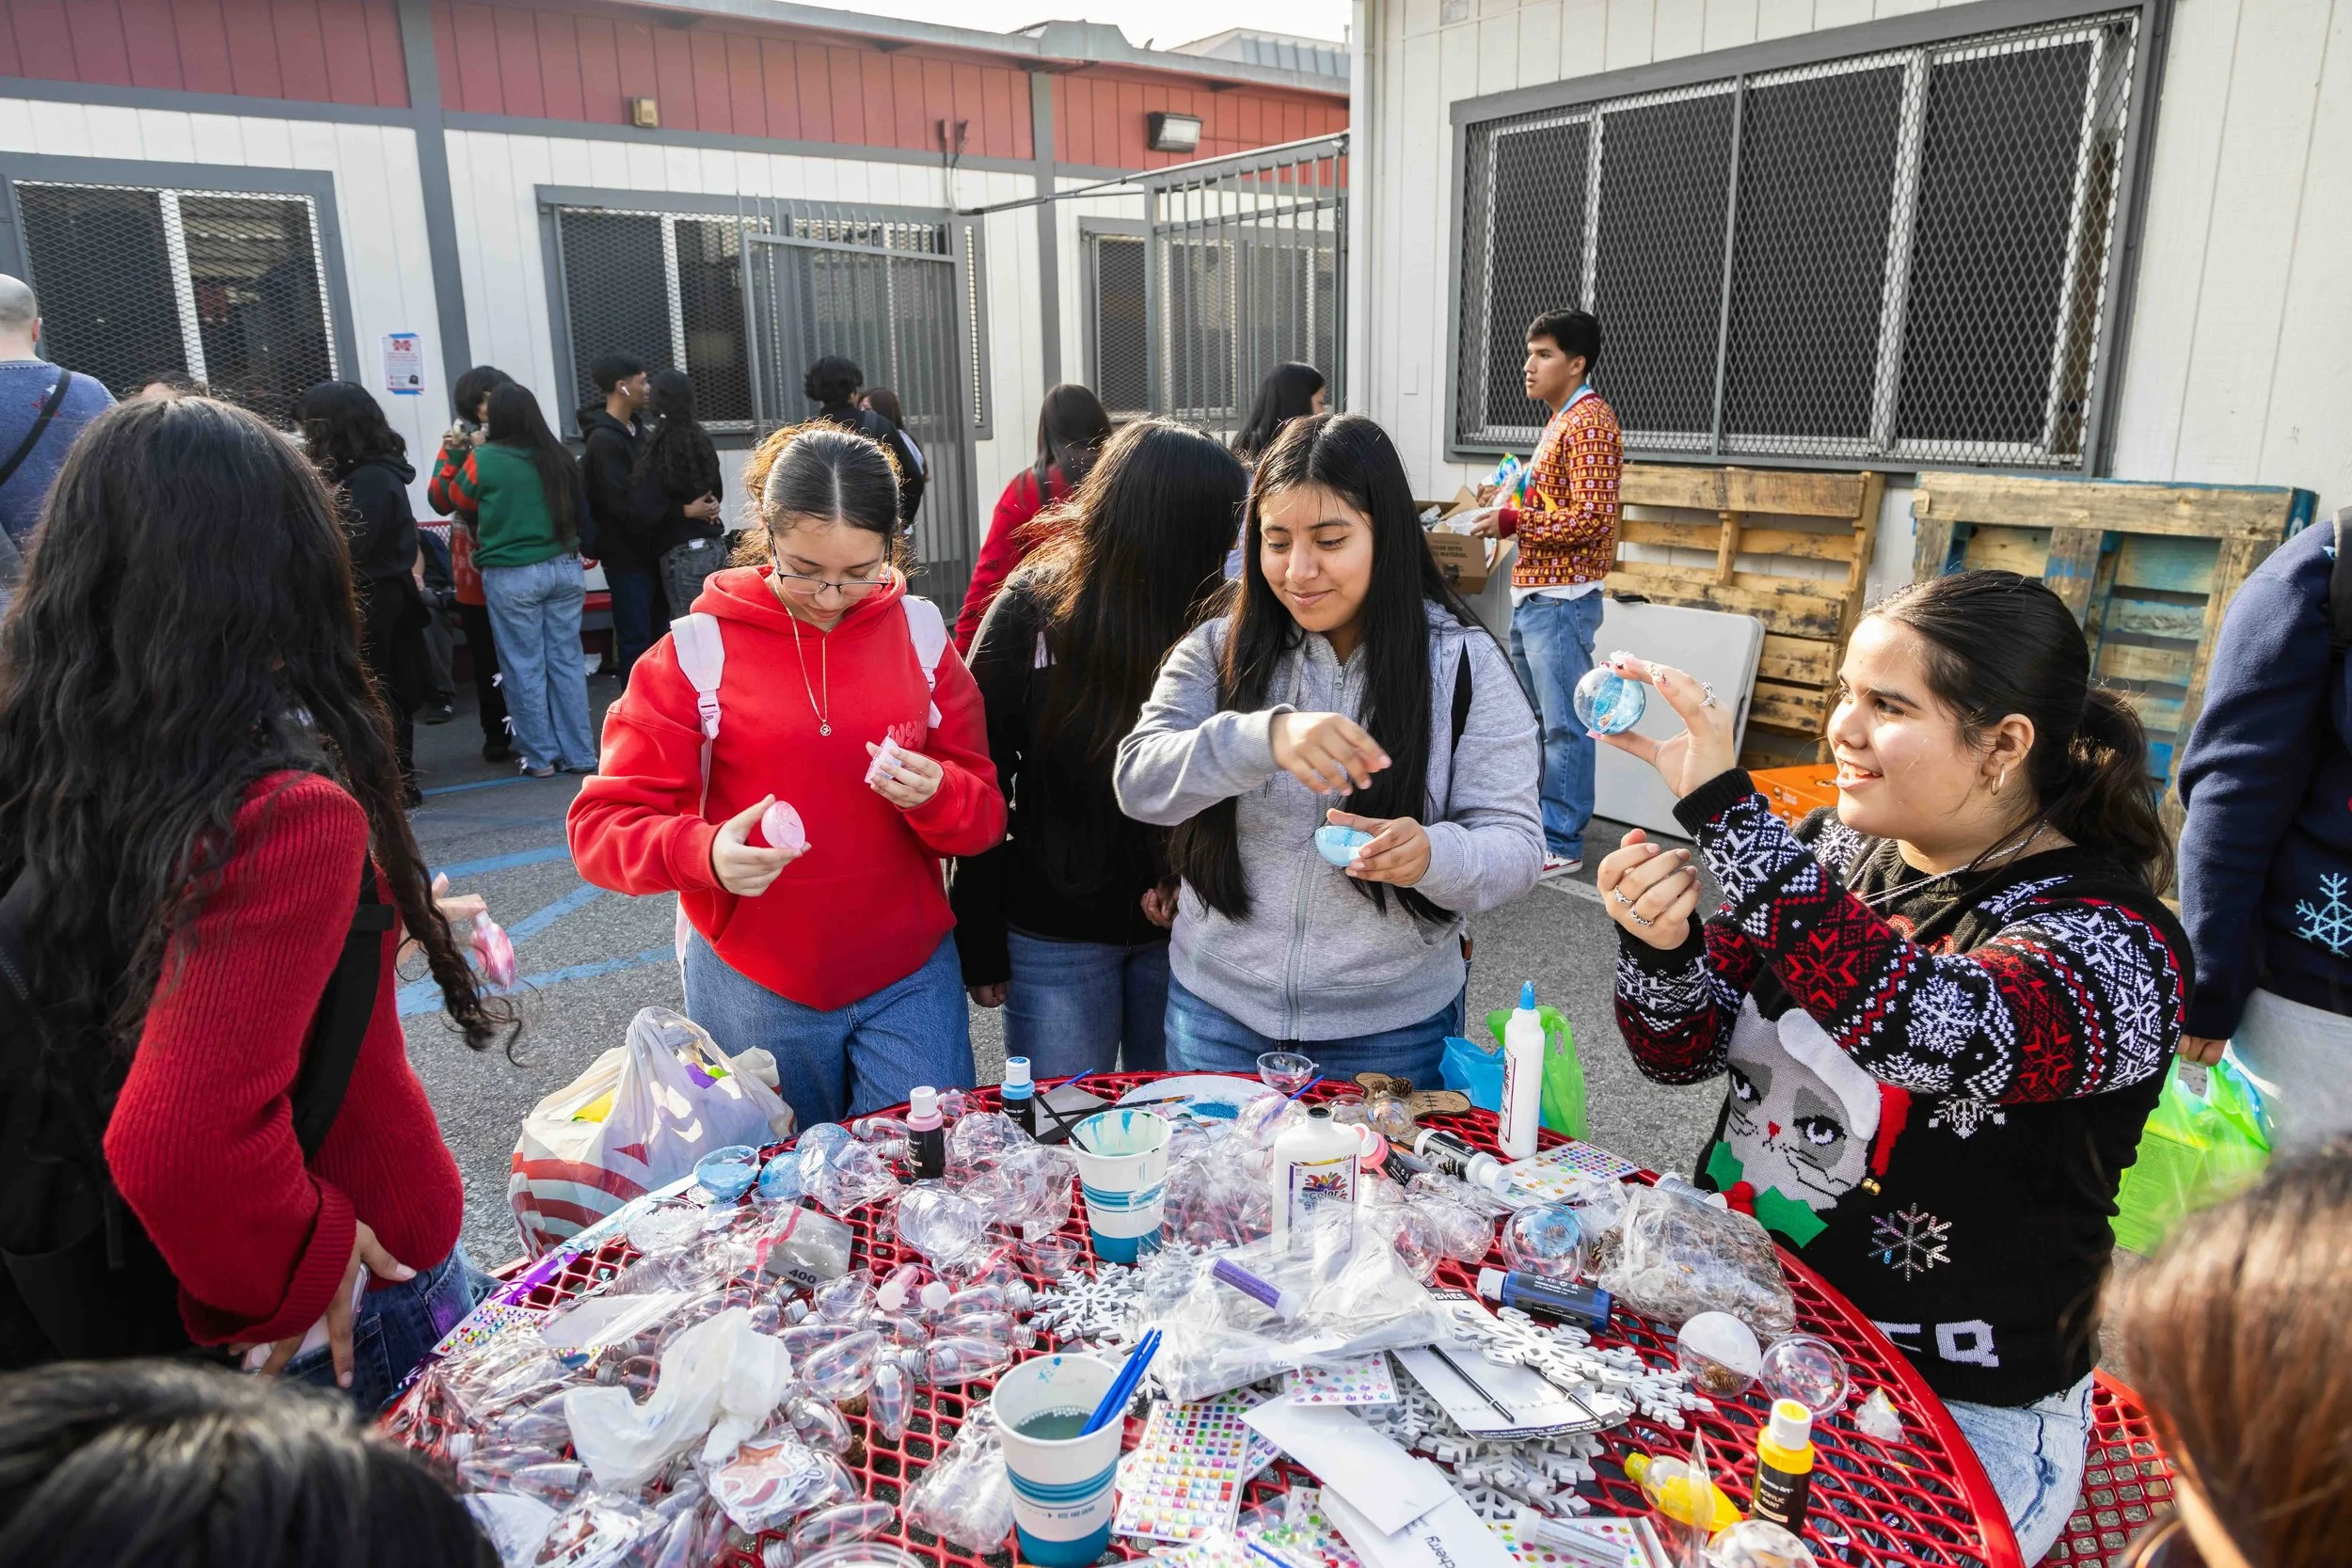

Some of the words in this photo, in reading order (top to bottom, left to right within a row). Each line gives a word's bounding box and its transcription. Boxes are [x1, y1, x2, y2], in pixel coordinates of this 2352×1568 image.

[788, 1269, 817, 1284] 400
[1760, 1488, 1785, 1504] ACRYLIC
[1762, 1497, 1780, 1509] PAINT
